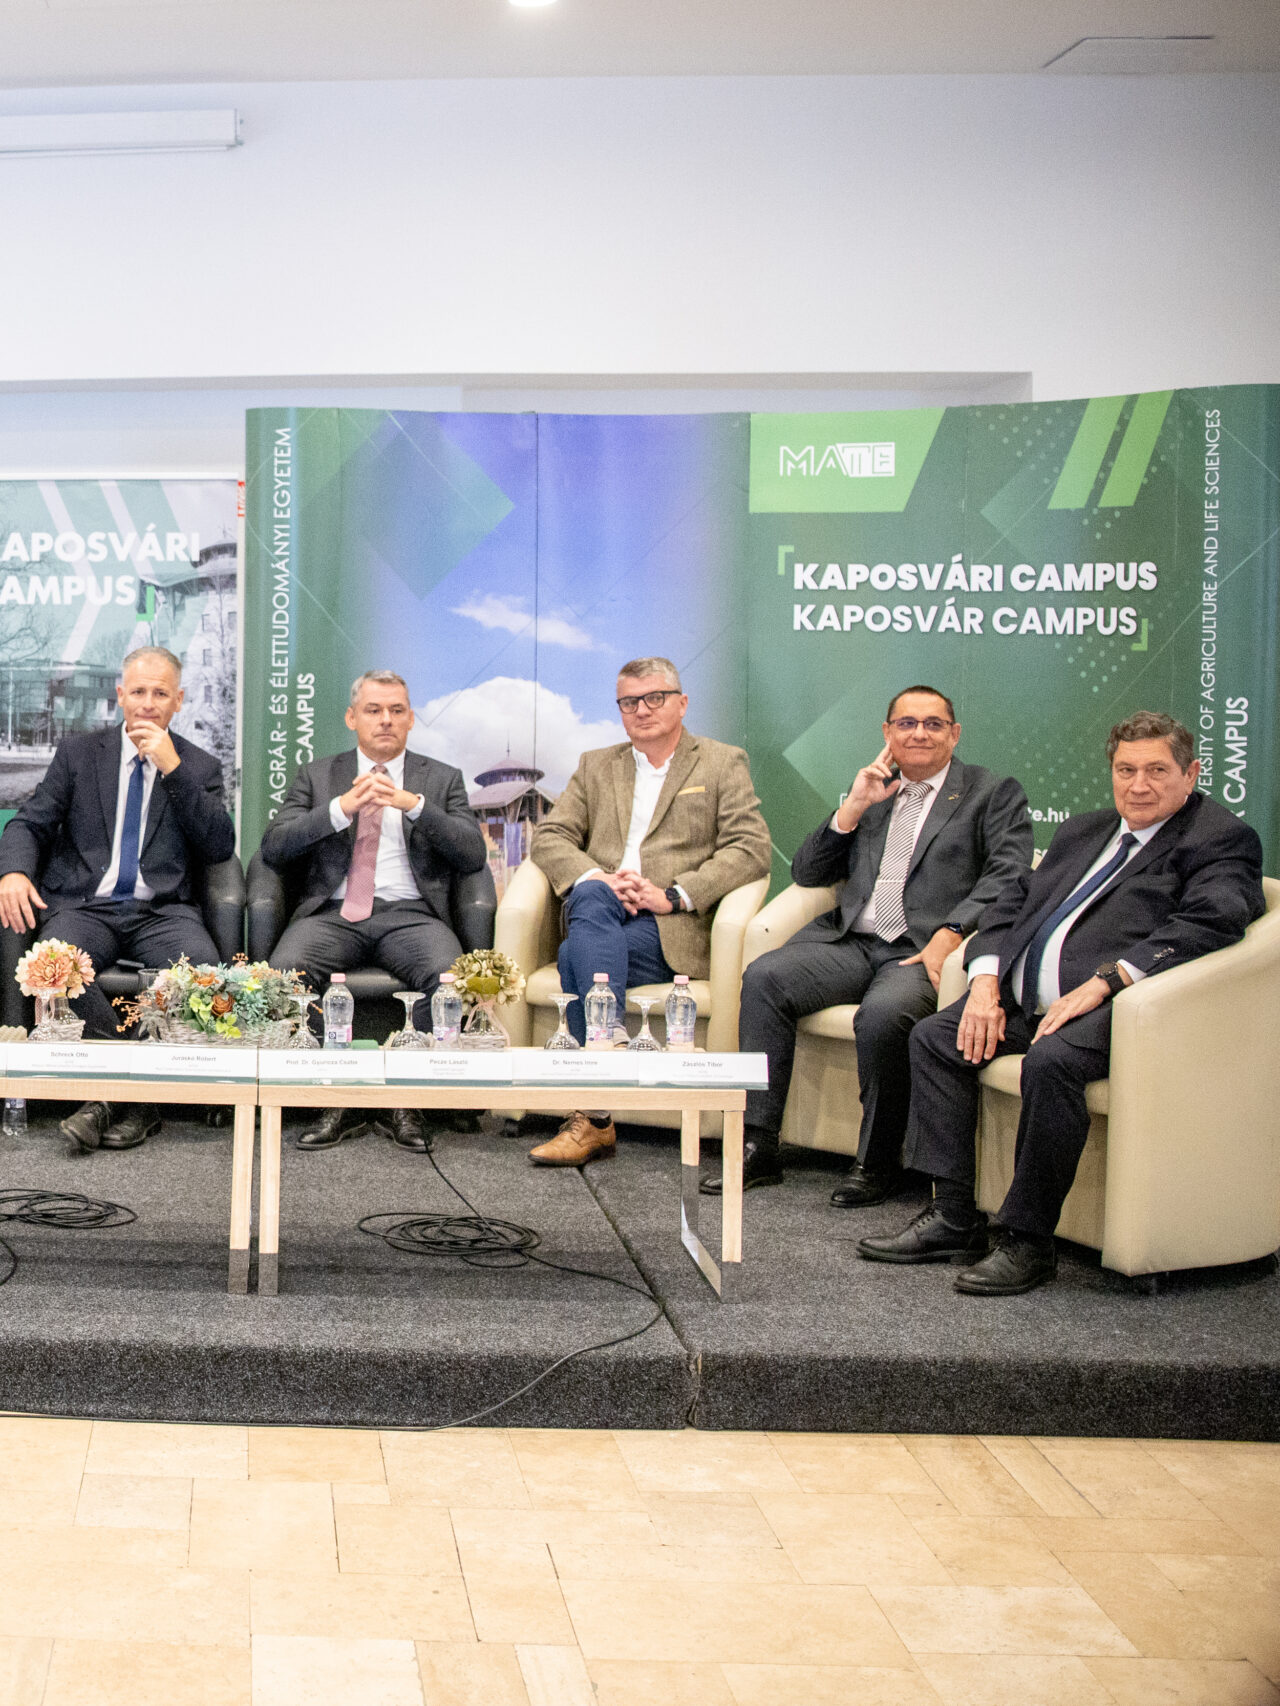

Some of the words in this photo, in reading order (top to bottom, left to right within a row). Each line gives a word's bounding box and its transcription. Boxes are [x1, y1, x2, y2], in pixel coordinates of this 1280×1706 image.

[273, 427, 291, 518] EGYETEM
[779, 441, 896, 478] MATE
[1205, 409, 1221, 495] SCIENCES
[1204, 499, 1219, 531] LIFE
[793, 552, 1004, 592] KAPOSVÁRI
[1010, 561, 1158, 592] CAMPUS
[1203, 536, 1219, 577] AND
[269, 524, 291, 688] ÉLETTUDOMÁNYI
[793, 596, 984, 635] KAPOSVÁR
[991, 606, 1138, 636] CAMPUS
[1200, 581, 1218, 702] AGRICULTURE
[268, 693, 288, 715] ÉS
[295, 672, 315, 766] CAMPUS
[1199, 704, 1215, 730] OF
[1198, 733, 1214, 796] VERSITY
[1222, 696, 1249, 804] CAMPUS
